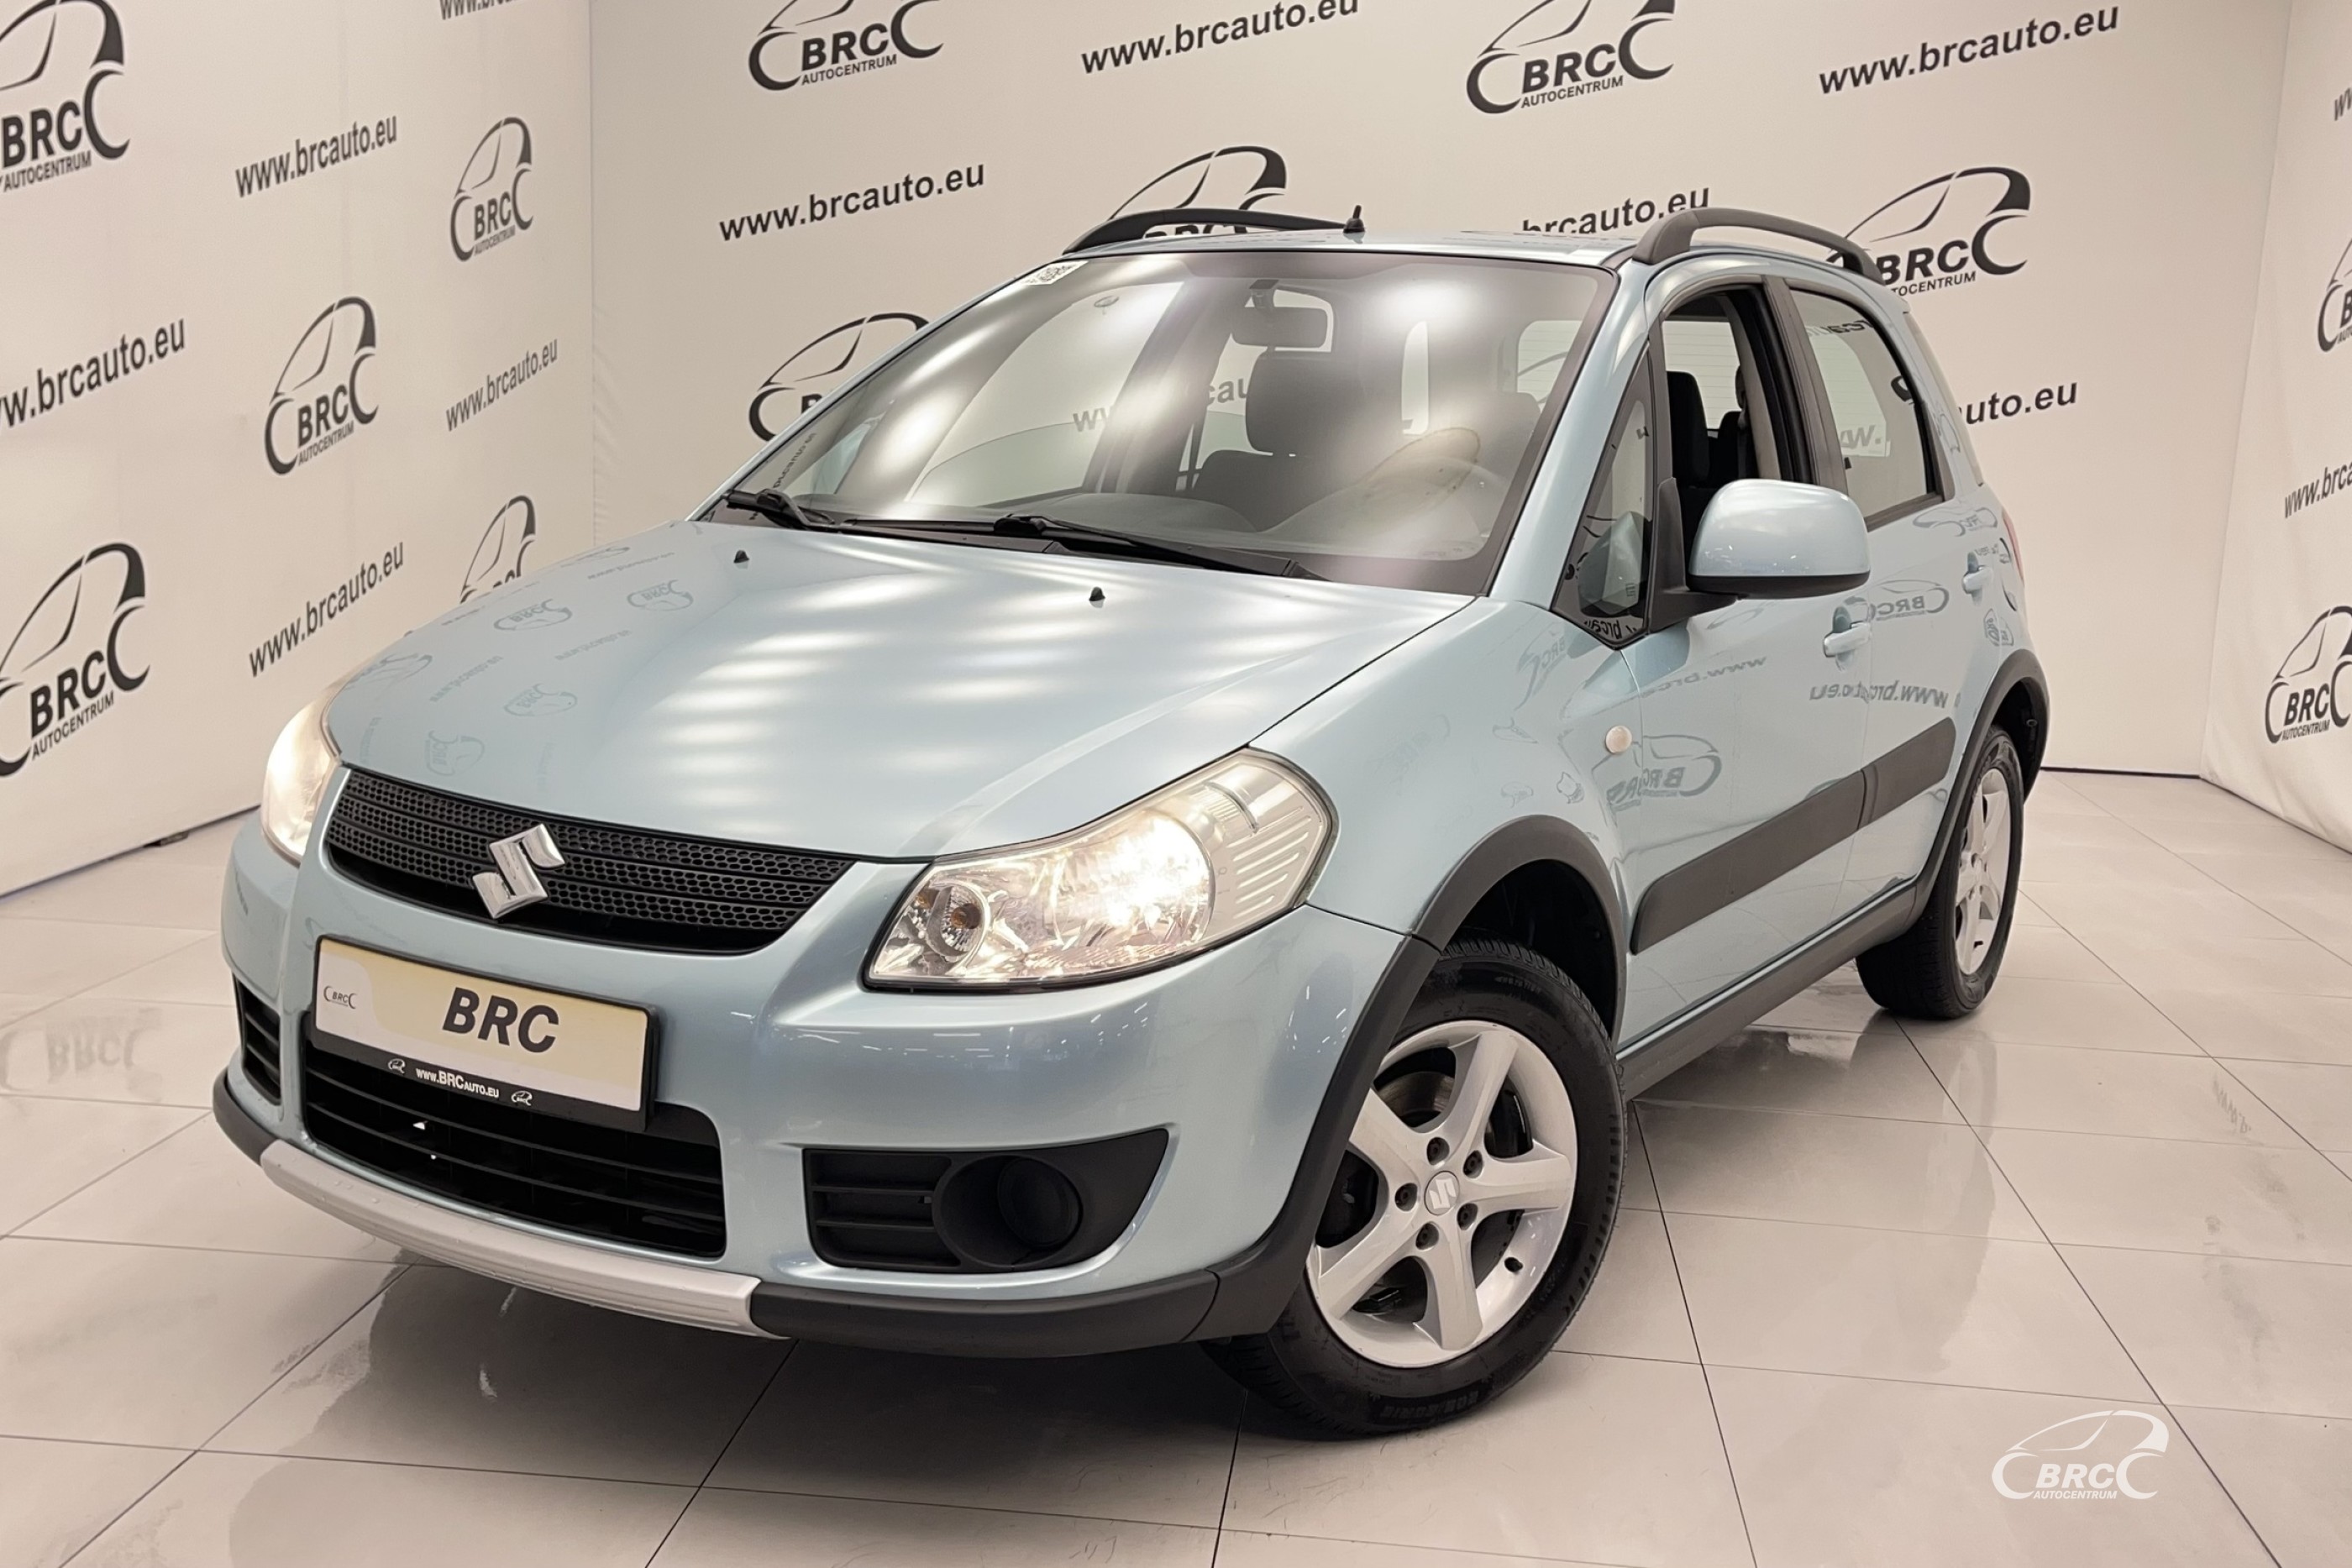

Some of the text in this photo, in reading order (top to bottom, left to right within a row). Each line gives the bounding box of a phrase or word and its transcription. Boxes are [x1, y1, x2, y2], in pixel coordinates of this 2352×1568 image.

[801, 54, 897, 86] AUTOCENTRUM
[802, 24, 889, 71] BRC
[1521, 44, 1616, 93] BRC
[1819, 7, 2118, 93] www.brcauto.eu
[1521, 76, 1623, 108] AUTOCENTRUM
[3, 100, 82, 168] BRC
[235, 115, 396, 197] www.brcauto.eu
[3, 150, 92, 192] AUTOCENTRUM
[719, 165, 984, 241] www.brcauto.eu
[474, 191, 512, 241] BRC
[1876, 240, 1969, 286] BRC
[0, 318, 184, 427] w.brcauto.eu
[446, 338, 557, 432] www.brcauto.eu
[1959, 382, 2077, 425] uto.eu
[297, 384, 349, 448] BRC
[297, 420, 354, 467] AUTOCENTRUM
[249, 542, 403, 678] www.brcauto.eu
[30, 650, 106, 739] BRC
[32, 690, 114, 762] AUTOCENTRUM
[2283, 683, 2329, 726] BRC
[442, 987, 559, 1053] BRC
